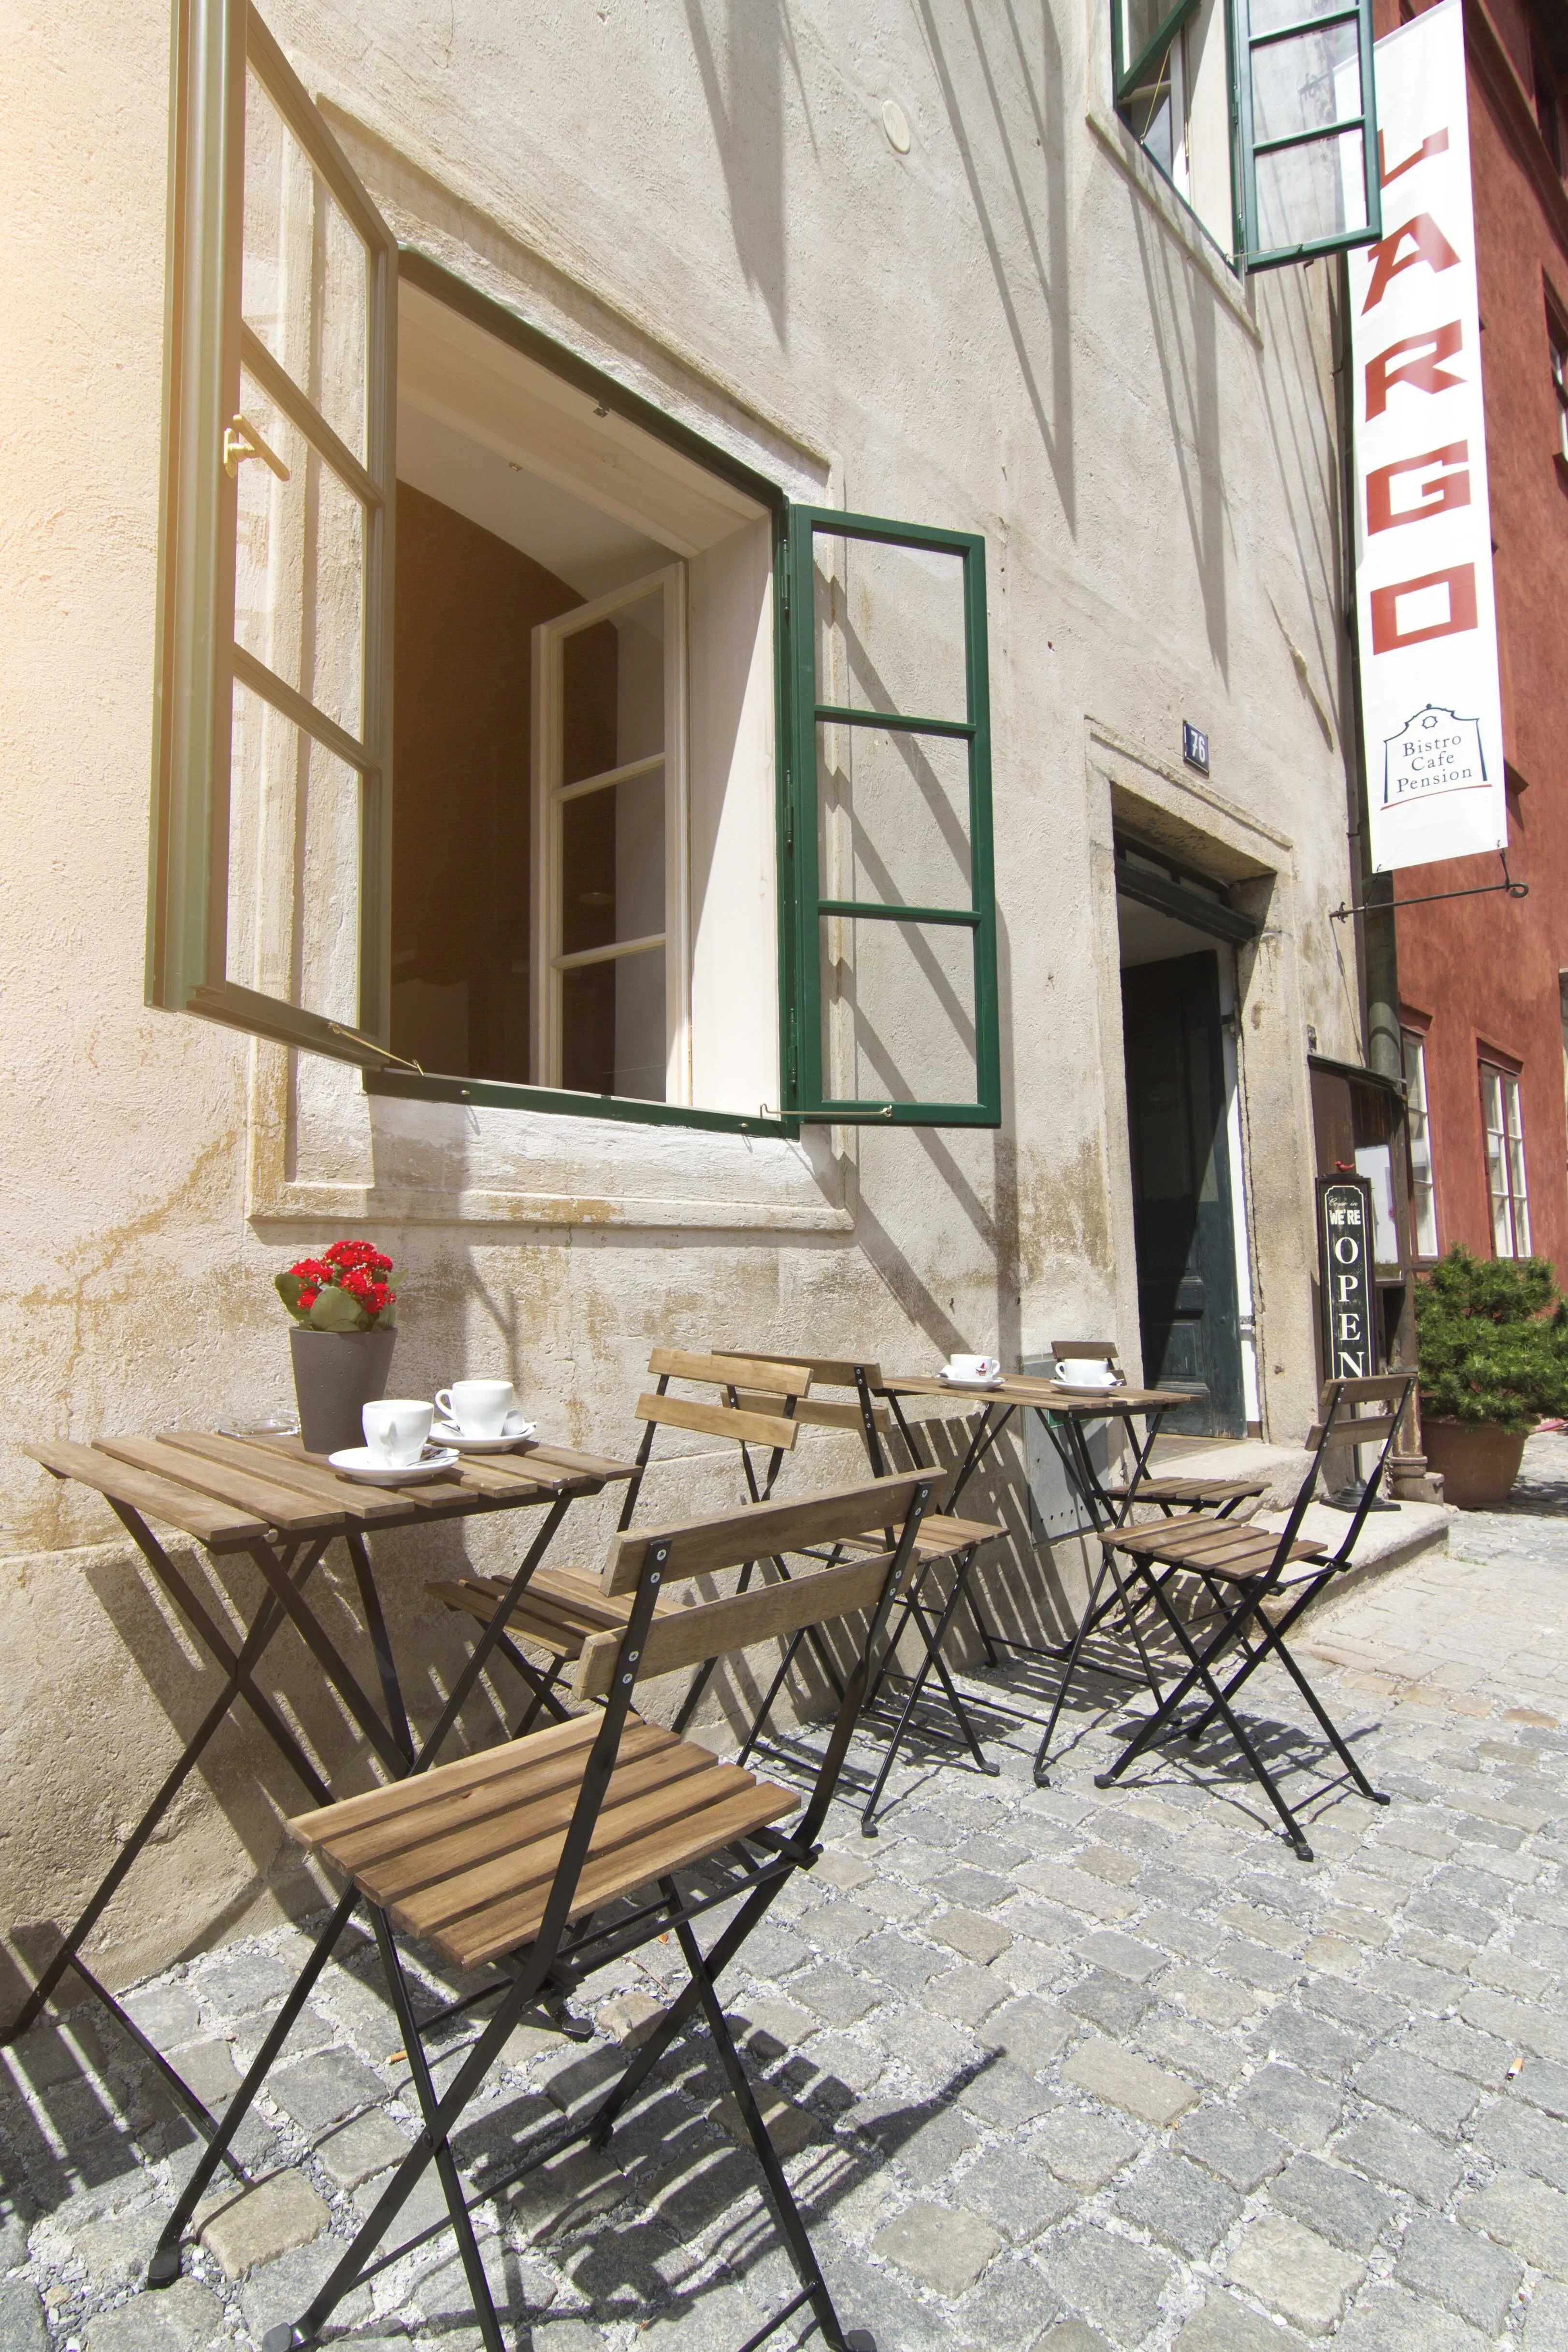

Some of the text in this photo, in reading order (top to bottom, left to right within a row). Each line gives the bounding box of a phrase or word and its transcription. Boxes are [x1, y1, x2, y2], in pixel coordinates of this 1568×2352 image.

[1191, 730, 1206, 762] 76
[1403, 735, 1461, 757] Bistro
[1411, 751, 1454, 771] Cafe
[1396, 768, 1472, 793] Pension
[1328, 1195, 1348, 1206] Come
[1329, 1209, 1361, 1225] WE'RE
[1335, 1236, 1365, 1379] OPEN
